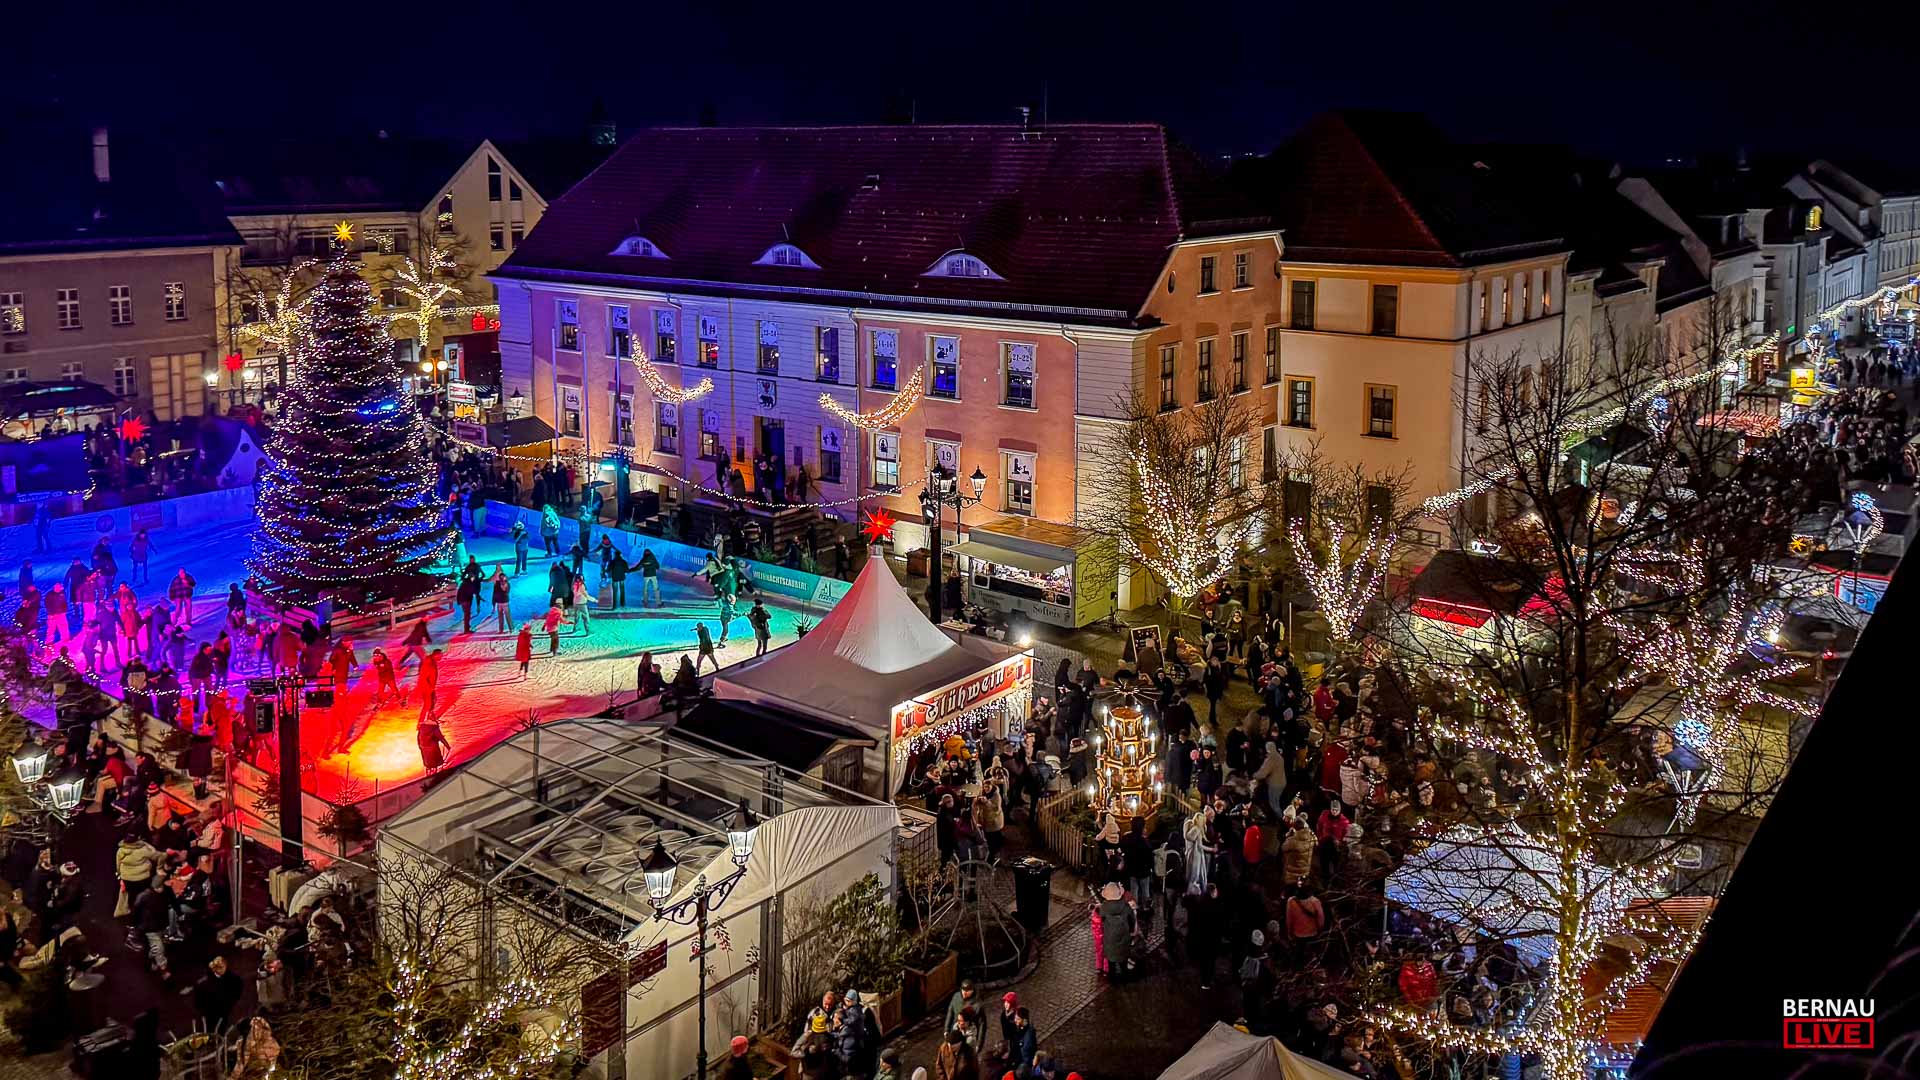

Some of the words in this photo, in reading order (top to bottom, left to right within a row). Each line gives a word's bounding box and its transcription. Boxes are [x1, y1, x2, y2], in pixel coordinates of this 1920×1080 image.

[663, 317, 672, 327] 18
[1012, 353, 1030, 362] 21-22
[665, 409, 675, 418] 20
[707, 415, 716, 425] 17
[940, 450, 952, 462] 19
[1032, 604, 1061, 618] Softeis
[925, 666, 1006, 724] Glühwein
